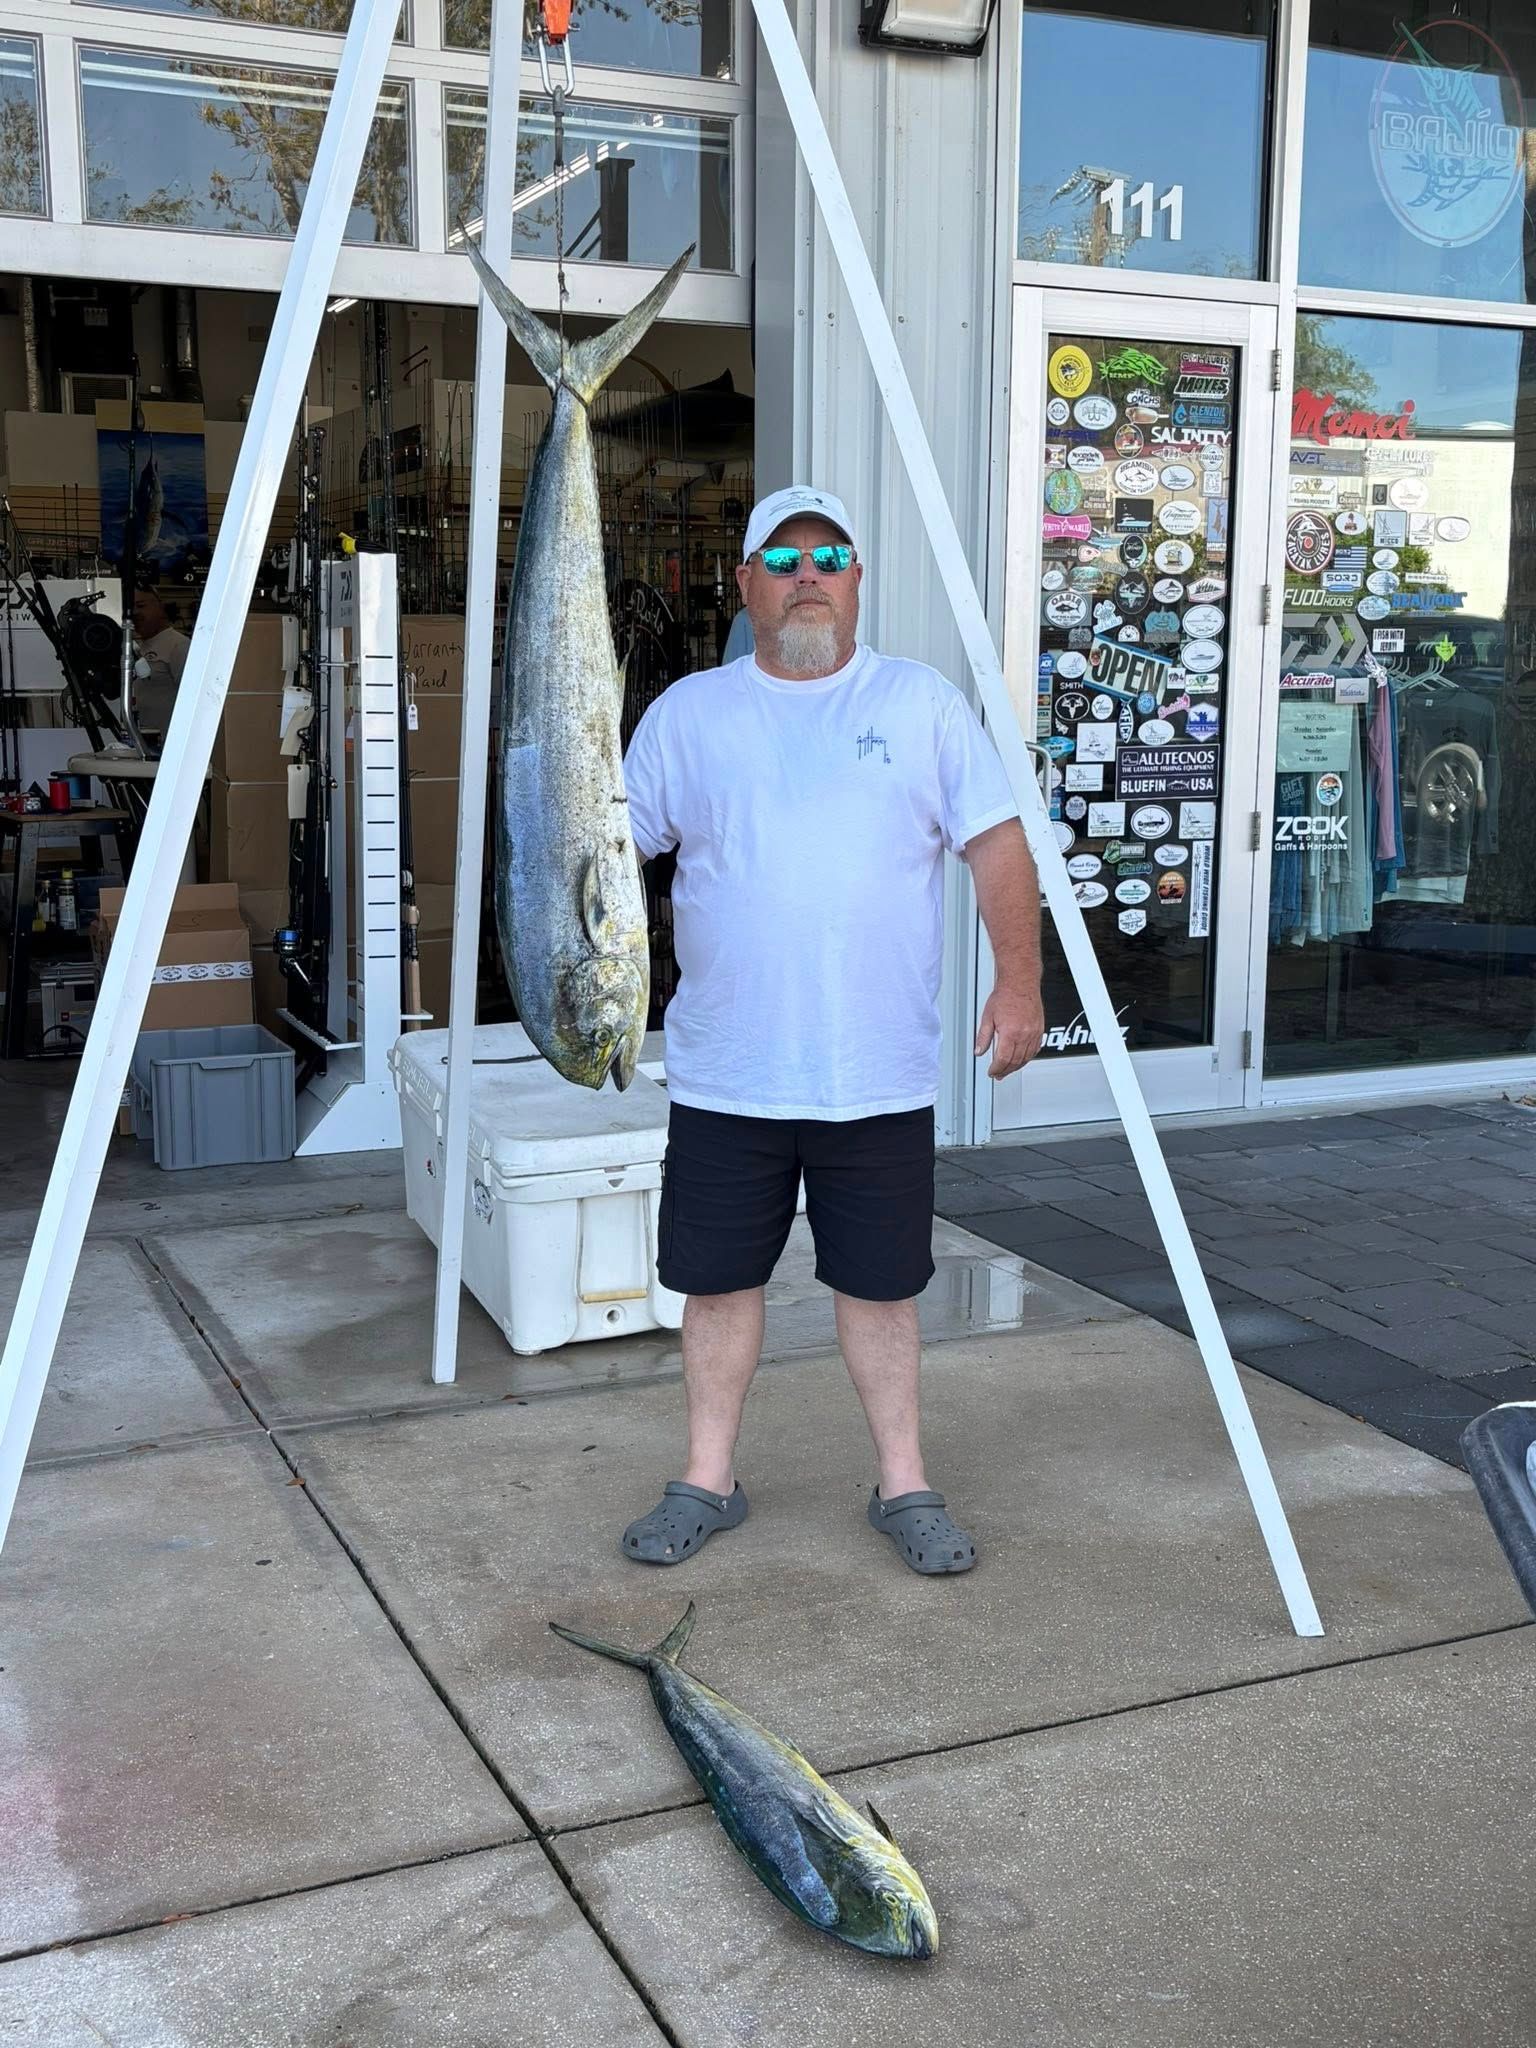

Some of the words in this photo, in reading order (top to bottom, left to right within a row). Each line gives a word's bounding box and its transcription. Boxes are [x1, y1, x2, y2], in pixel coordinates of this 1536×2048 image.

[1101, 178, 1183, 240] 111
[1151, 426, 1232, 446] SALINITY
[1314, 532, 1330, 566] LURES
[1324, 598, 1354, 607] HOOKS
[415, 665, 447, 688] Paid
[1091, 642, 1165, 698] OPEN
[1060, 682, 1084, 690] SMITH
[1281, 674, 1333, 687] Accurate
[1139, 750, 1215, 766] ALUTECNOS
[1133, 765, 1158, 773] ULTIMATE
[1183, 764, 1214, 772] EQUIPMENT
[1121, 779, 1166, 793] BLUEFIN
[1191, 778, 1214, 791] USA
[1281, 776, 1304, 794] GIFT
[1282, 790, 1304, 802] CARDS
[1275, 815, 1349, 841] ZOOK
[1274, 843, 1297, 851] Gaffs
[1299, 843, 1305, 851] &
[1307, 842, 1348, 852] Harpoons
